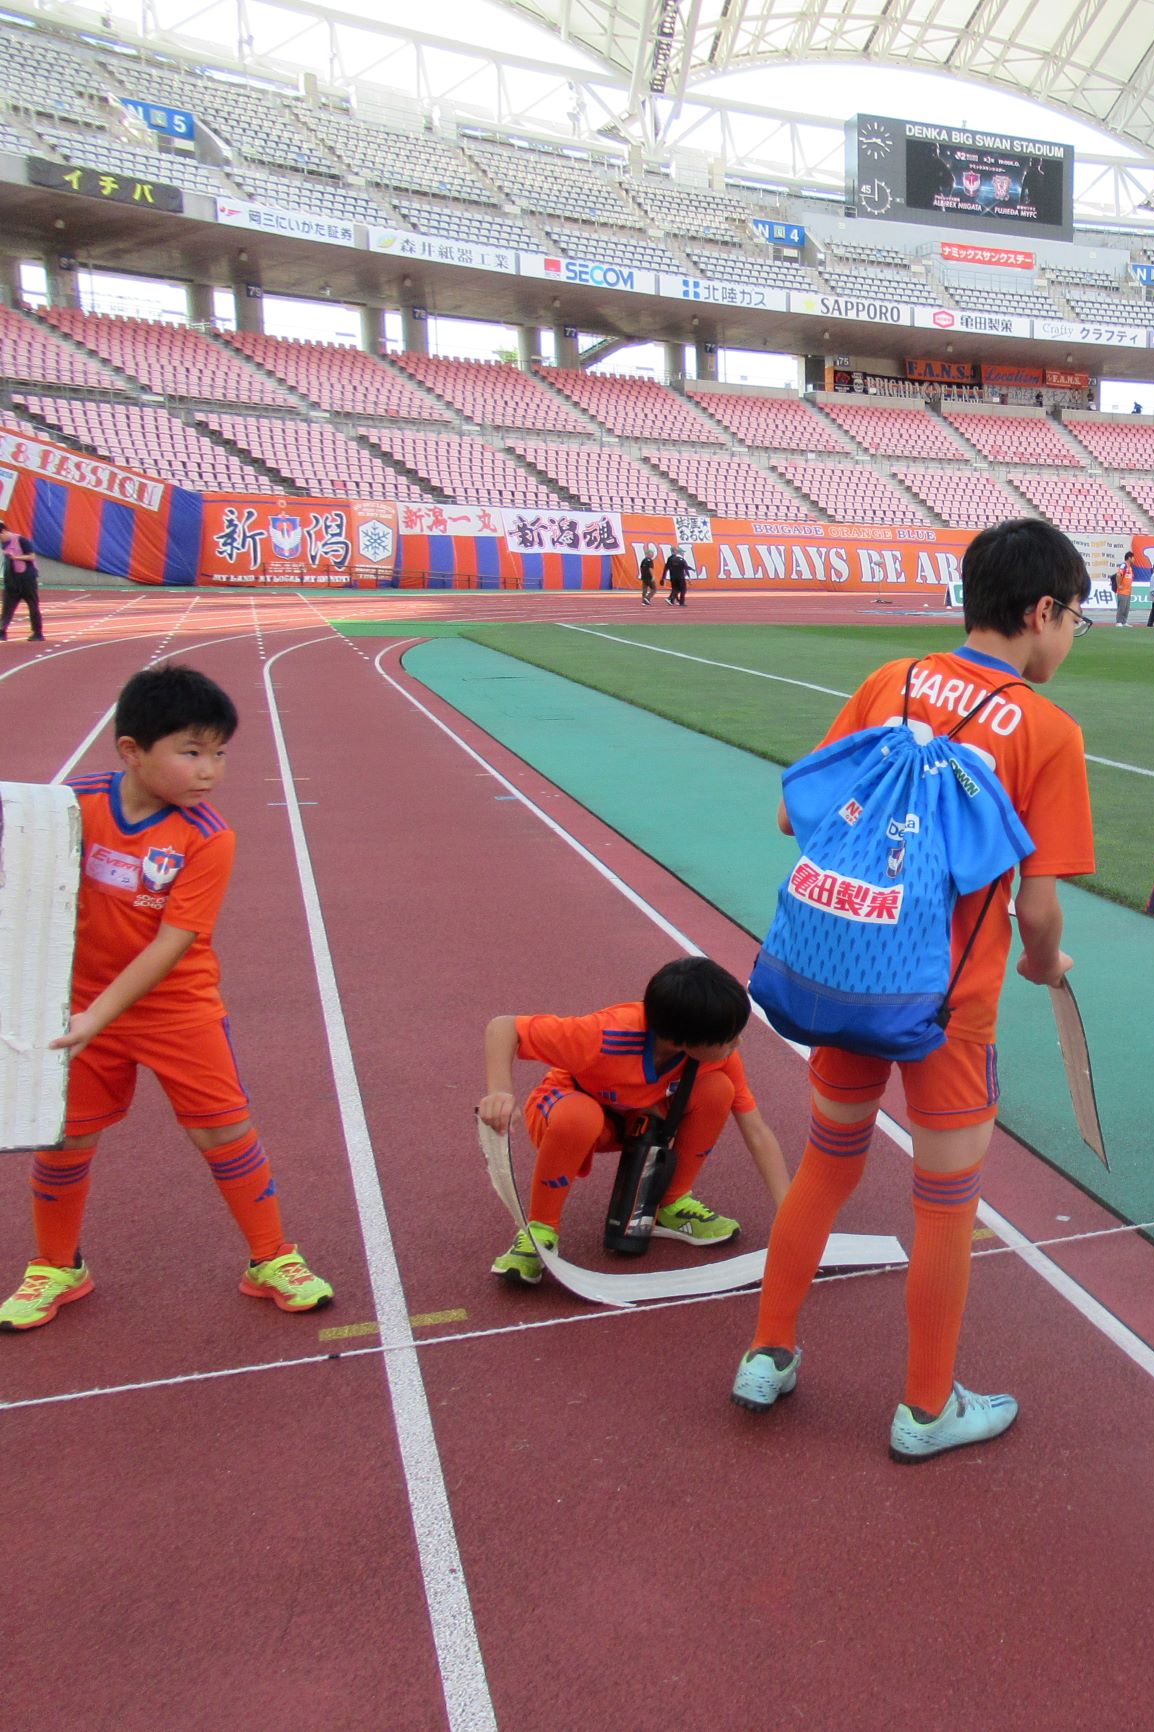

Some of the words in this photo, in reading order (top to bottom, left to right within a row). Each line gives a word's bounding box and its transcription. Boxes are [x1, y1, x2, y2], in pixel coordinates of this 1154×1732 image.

[173, 115, 186, 133] 5
[905, 124, 948, 142] DENKA
[952, 131, 972, 144] BIG
[975, 135, 1010, 150] SWAN
[1013, 139, 1064, 158] STADIUM
[861, 185, 871, 193] 45
[958, 203, 982, 211] NIIGATA
[994, 207, 1019, 216] FUJIEDA
[1020, 210, 1037, 218] MYFC
[249, 210, 352, 241] 岡三にいがた証券
[758, 224, 769, 238] N
[790, 229, 799, 242] 4
[400, 238, 510, 270] 森井紙器工業
[565, 261, 634, 289] SECOM
[1137, 268, 1146, 280] N
[704, 284, 767, 307] 北陸ガス
[820, 297, 901, 323] SAPPORO
[565, 327, 576, 336] 77
[960, 315, 1013, 333] 亀田製菓
[1042, 324, 1074, 339] Crafty
[1079, 327, 1138, 344] クラフティ
[838, 357, 849, 365] 75
[1088, 378, 1097, 386] 73
[11, 442, 30, 466] &
[402, 505, 498, 533] 新潟一丸
[213, 507, 351, 572] 新潟
[509, 513, 620, 550] 新潟魂
[752, 523, 825, 537] BRIGADE
[829, 526, 893, 539] ORANGE
[896, 528, 936, 541] BLUE
[718, 544, 849, 583] ALWAYS
[857, 549, 906, 583] BE
[915, 551, 962, 585] AR
[901, 667, 1022, 736] HARUTO
[888, 819, 916, 838] Dea
[791, 863, 901, 919] 亀田製菓
